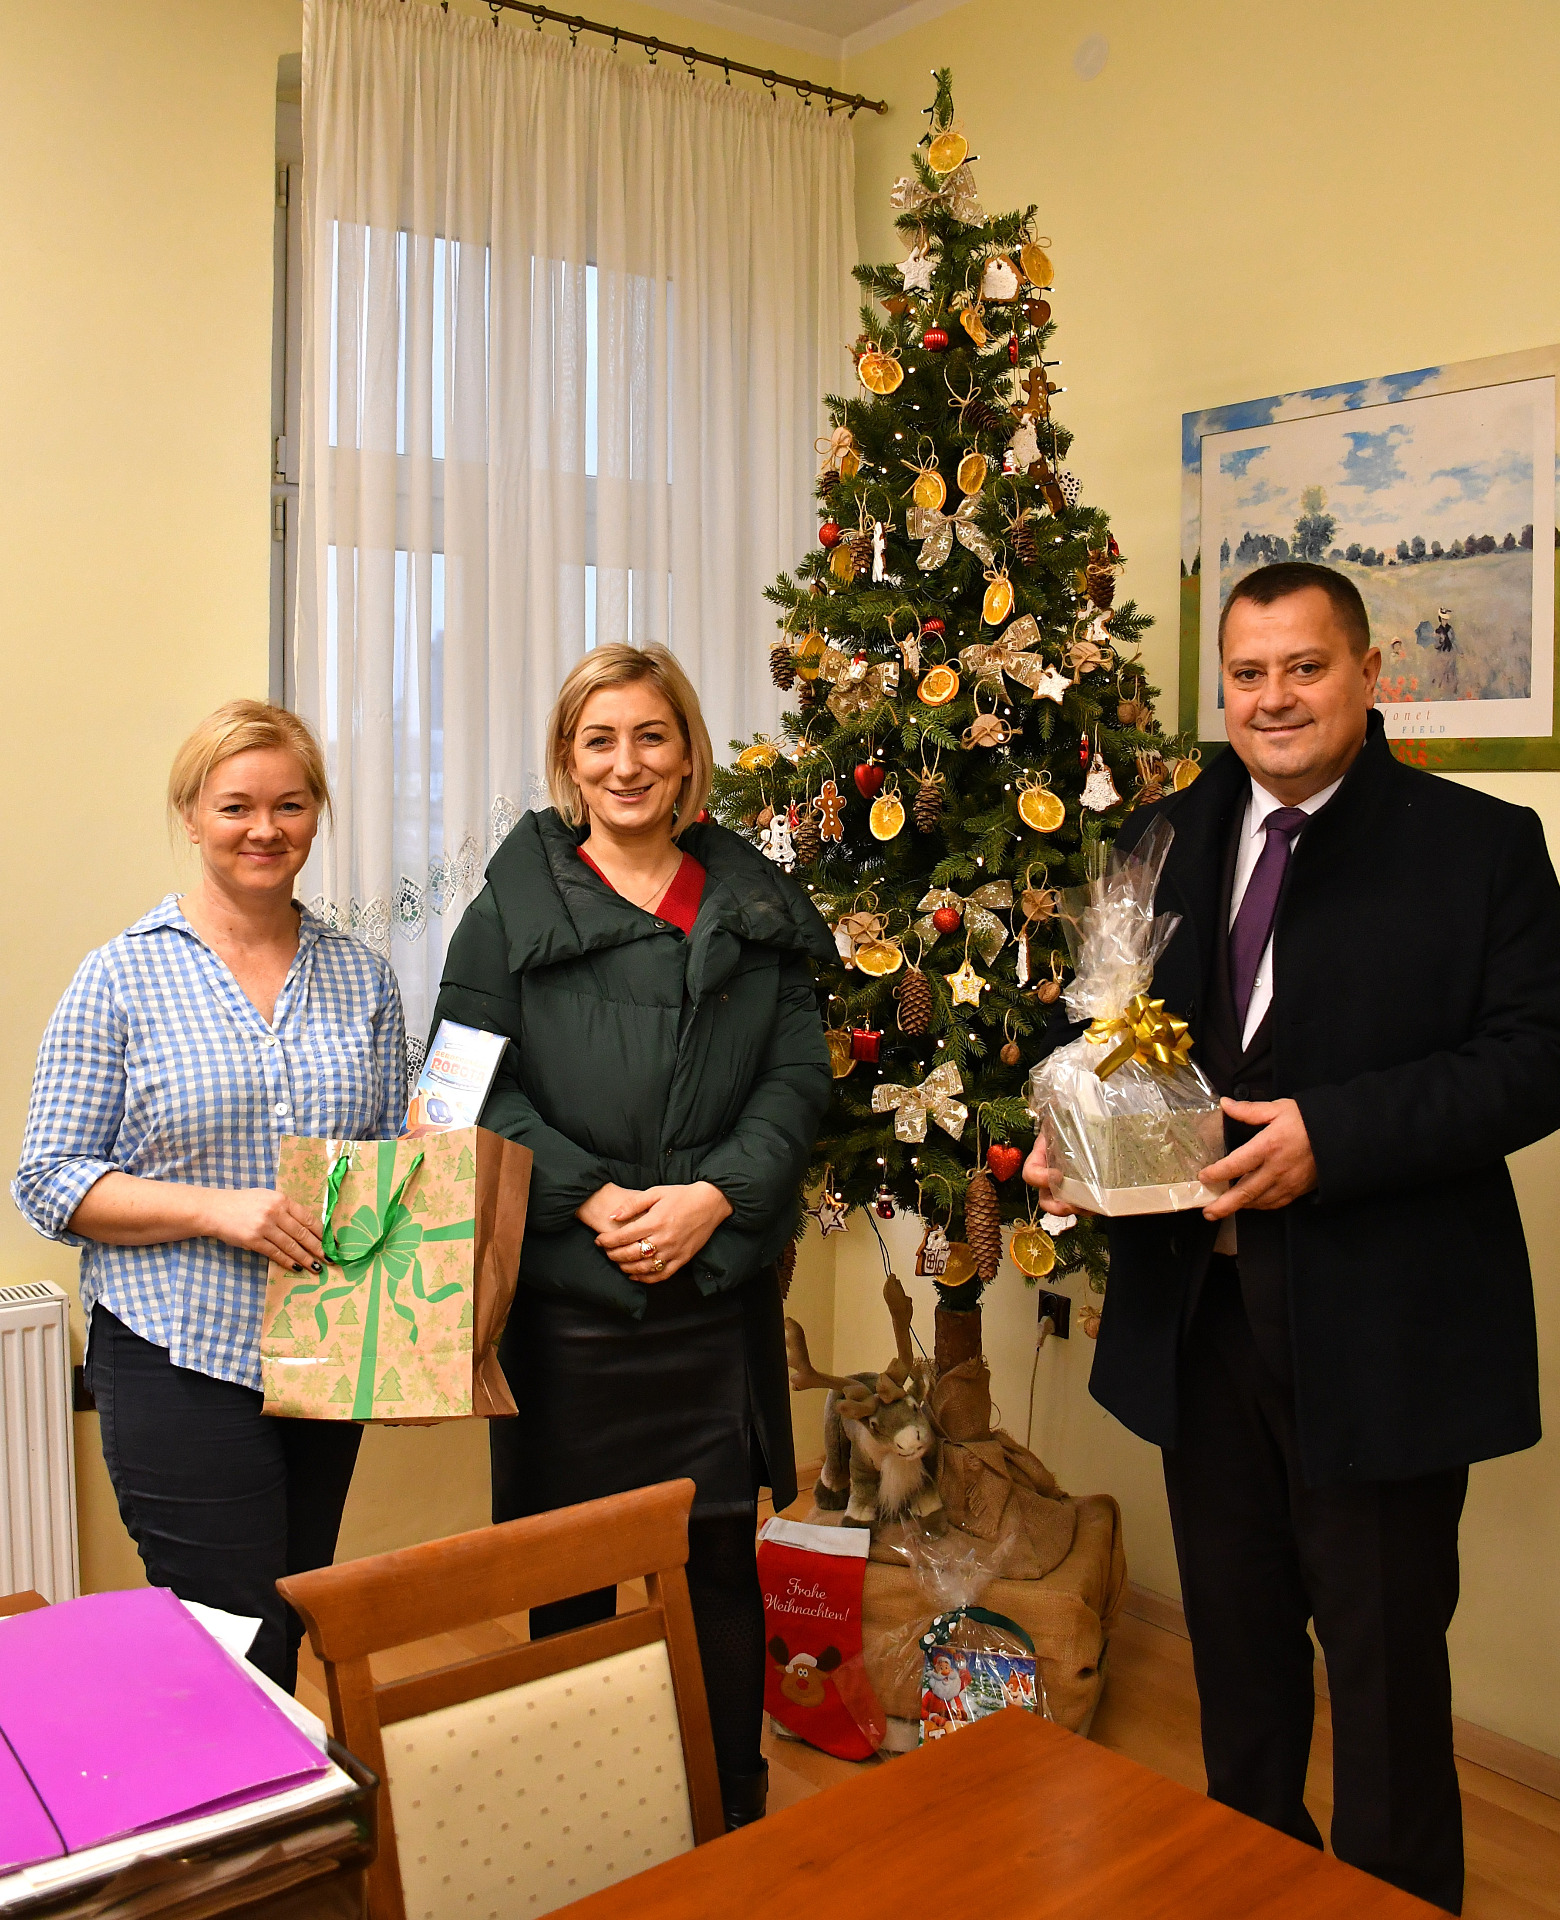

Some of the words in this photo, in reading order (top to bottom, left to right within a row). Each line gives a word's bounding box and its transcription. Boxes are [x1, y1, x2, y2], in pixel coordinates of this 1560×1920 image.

[1402, 725, 1446, 734] FIELD
[431, 1057, 487, 1082] ROBOTA
[786, 1577, 827, 1600] Frohe
[764, 1592, 850, 1622] Weihnachten!
